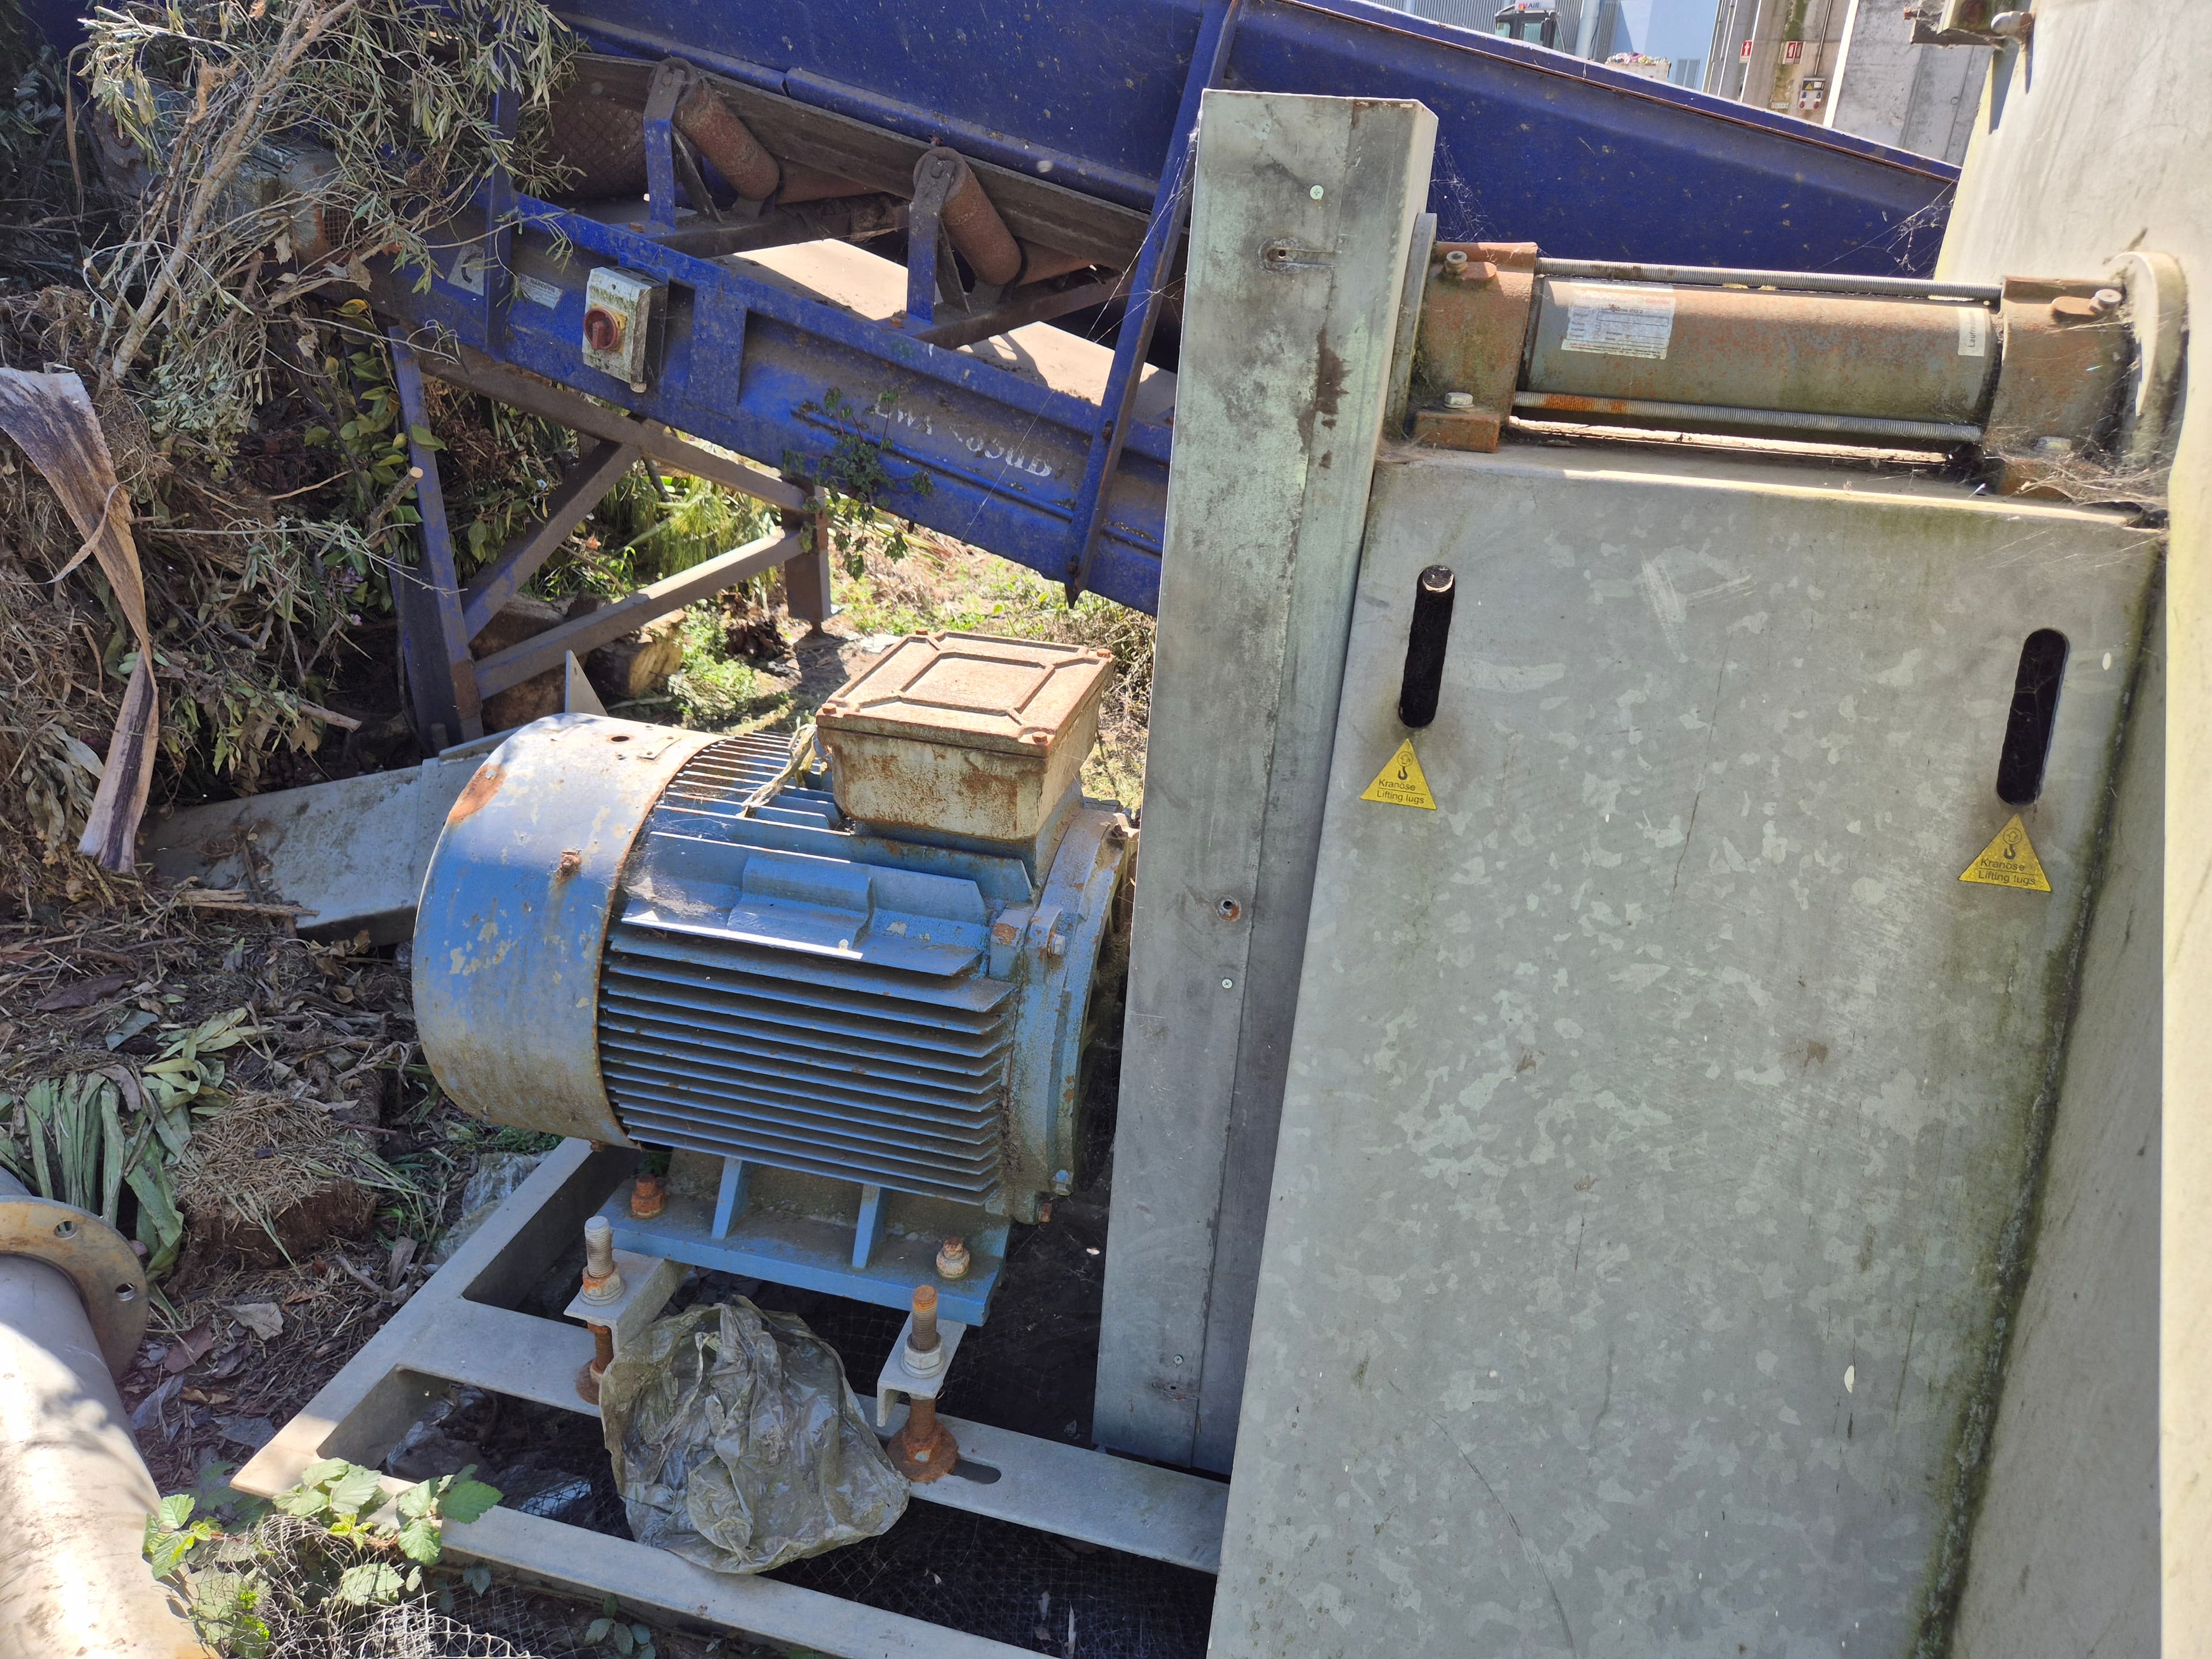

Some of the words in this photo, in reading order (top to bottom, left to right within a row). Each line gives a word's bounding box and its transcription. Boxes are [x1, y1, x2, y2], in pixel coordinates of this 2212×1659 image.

[530, 279, 555, 293] MARCOVIL
[1378, 779, 1415, 790] Kranöse
[1377, 790, 1403, 802] Lifting
[1406, 795, 1424, 804] lugs
[1980, 858, 2025, 871] Kranöse
[1978, 870, 2010, 884] Lifting
[2014, 875, 2036, 886] lugs
